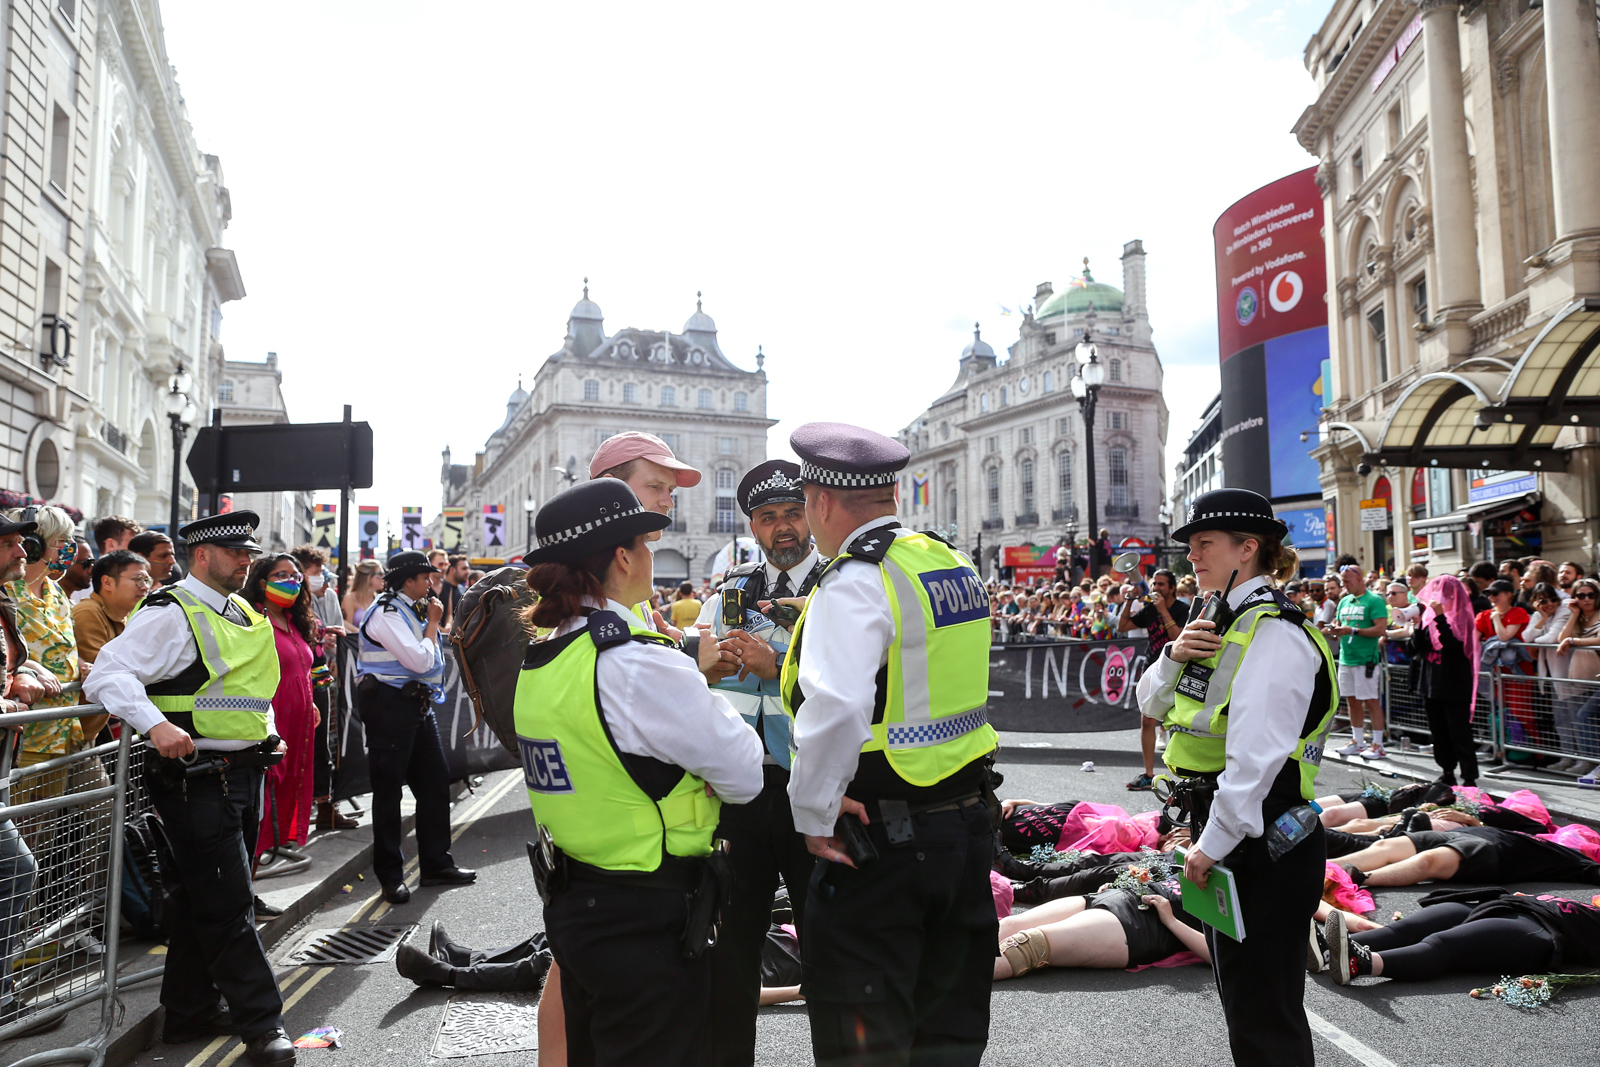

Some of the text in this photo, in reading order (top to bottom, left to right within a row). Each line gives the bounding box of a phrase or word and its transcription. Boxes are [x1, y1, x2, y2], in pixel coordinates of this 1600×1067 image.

[1251, 202, 1295, 226] Wimbledon
[1232, 227, 1267, 250] Wimbledon
[1267, 207, 1314, 233] Uncovered
[1257, 237, 1273, 251] 360
[1231, 250, 1307, 287] Powered by Vodafone.
[1240, 416, 1264, 431] before
[927, 575, 989, 616] POLICE
[599, 627, 621, 638] 753
[600, 622, 614, 631] CO
[1177, 685, 1205, 698] POLICE OFFICER
[1190, 682, 1202, 690] POLICE
[517, 742, 567, 787] LICE
[1050, 806, 1065, 817] WE
[1018, 808, 1053, 837] CONSENT
